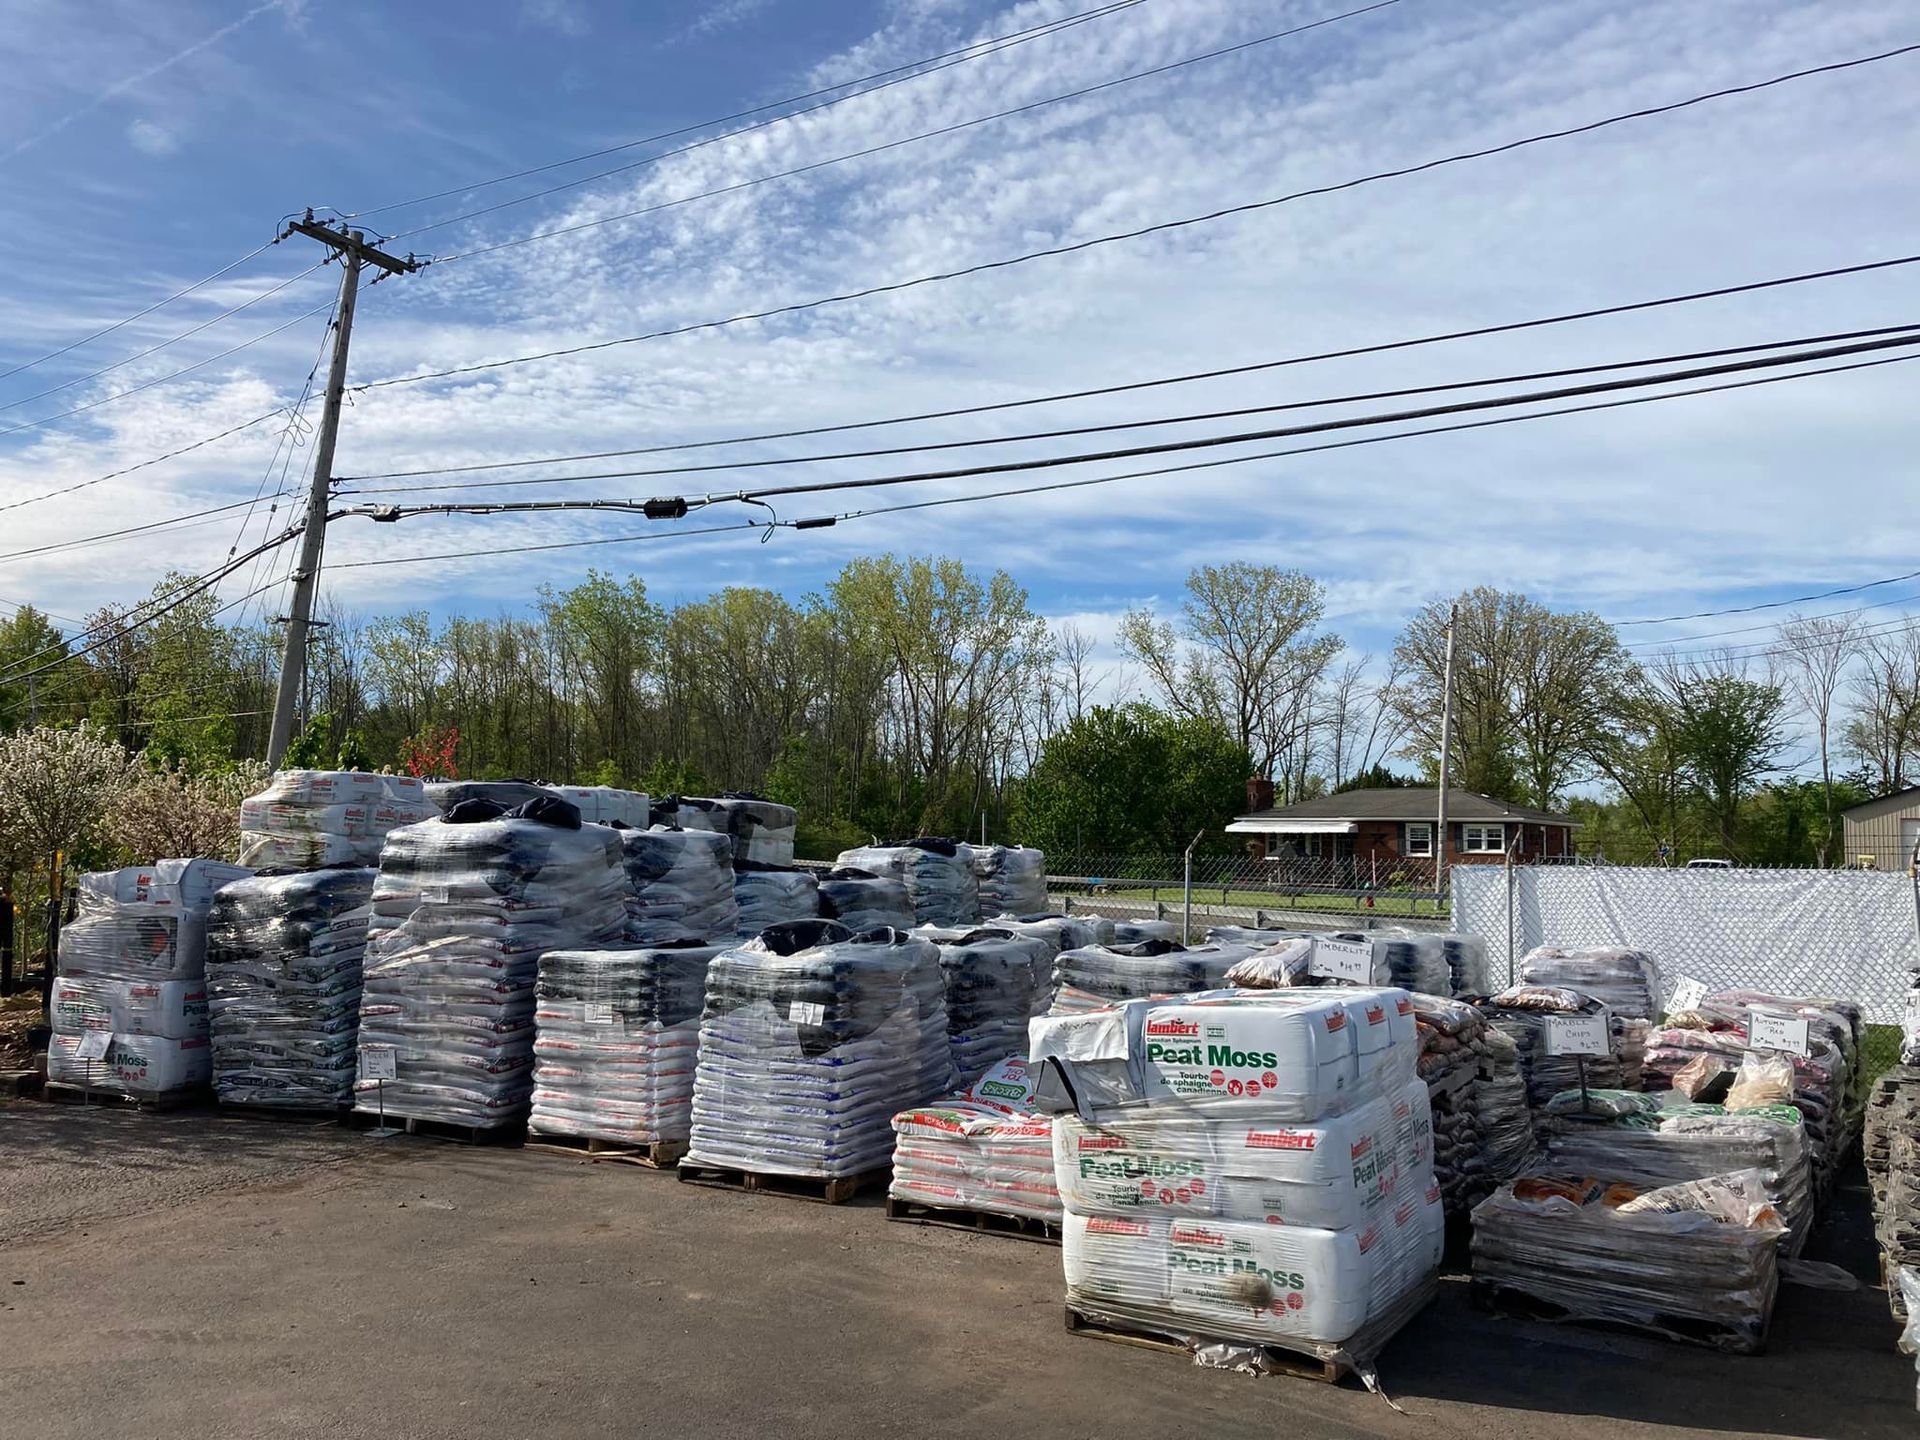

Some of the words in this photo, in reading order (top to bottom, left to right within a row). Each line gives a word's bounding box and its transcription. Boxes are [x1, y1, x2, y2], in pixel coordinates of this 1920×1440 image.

[1147, 1019, 1200, 1034] lambert
[118, 1054, 148, 1067] Moss
[1147, 1043, 1203, 1065] Peat
[1208, 1045, 1278, 1068] Moss
[1180, 1071, 1209, 1080] Tourbe
[1174, 1079, 1212, 1088] sphaigne
[1177, 1087, 1227, 1096] canadienne
[1246, 1128, 1316, 1148] lambert
[1080, 1159, 1133, 1178] Peat
[1353, 1159, 1375, 1188] Peat
